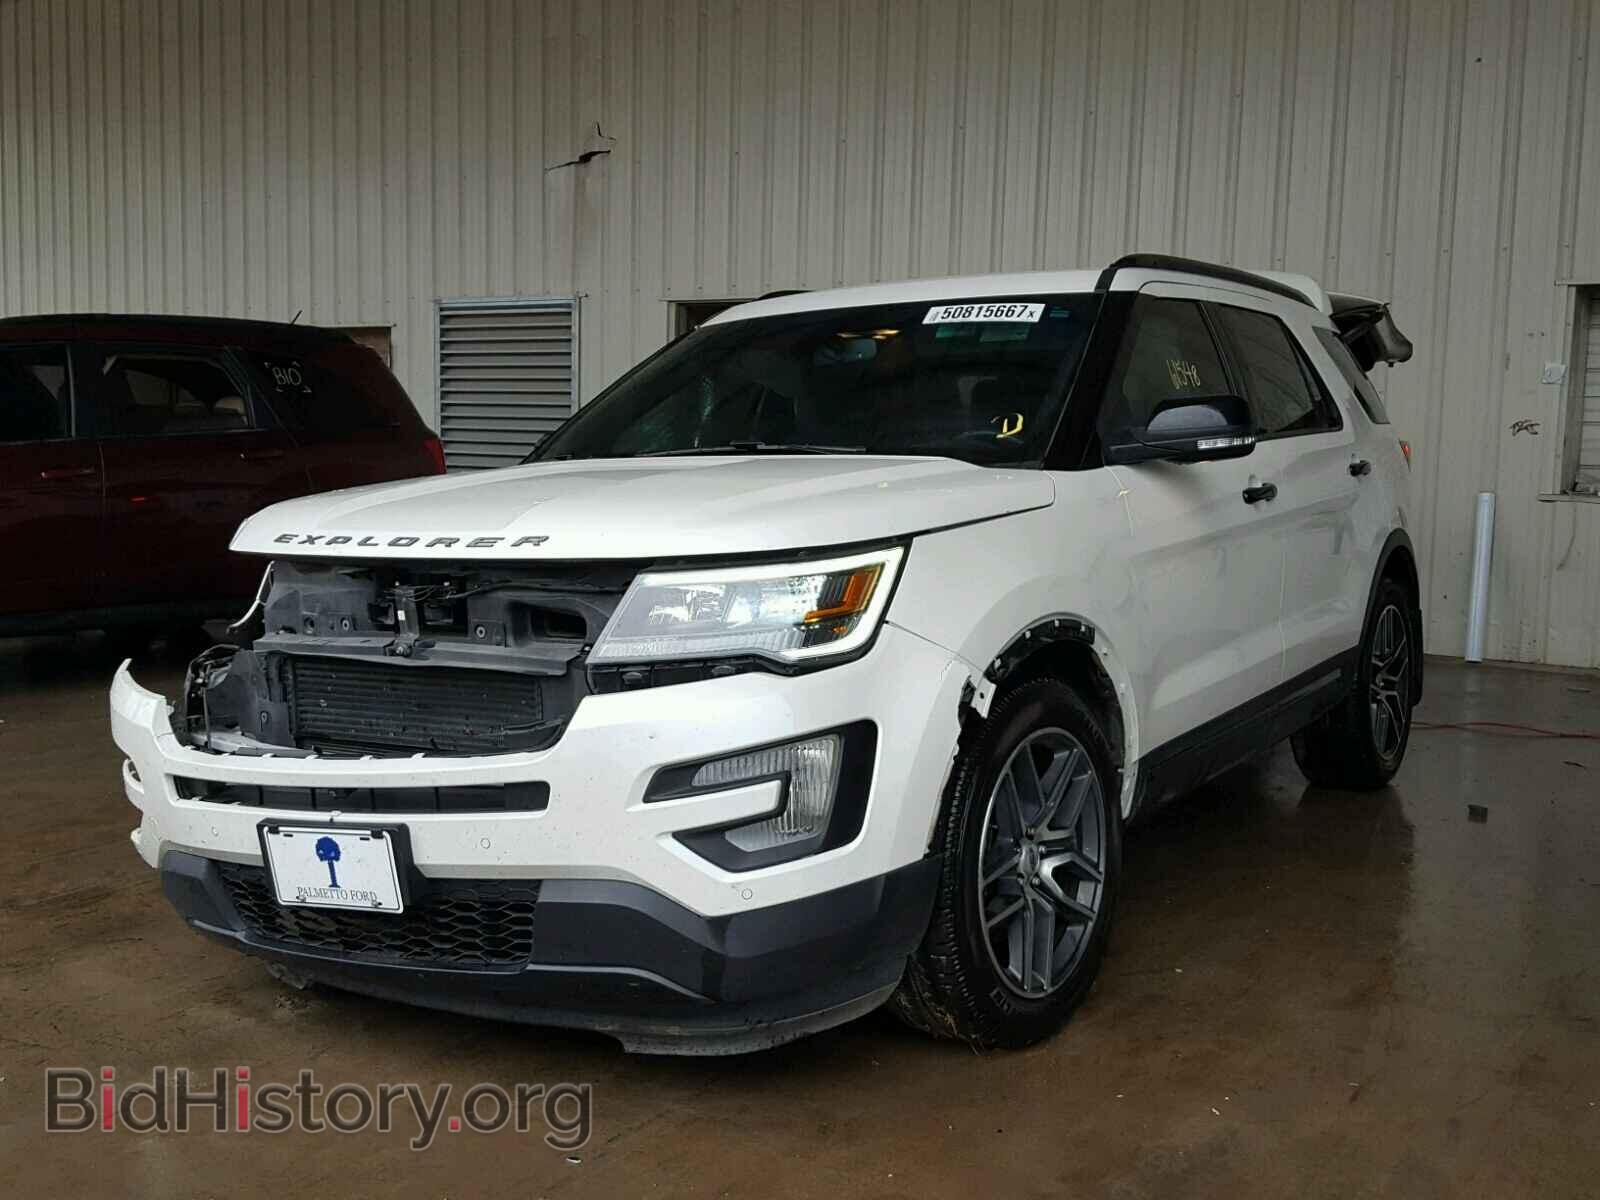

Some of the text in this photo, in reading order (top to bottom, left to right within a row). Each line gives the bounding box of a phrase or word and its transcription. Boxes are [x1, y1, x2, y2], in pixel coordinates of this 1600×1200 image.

[941, 305, 1028, 320] 50815667
[273, 532, 550, 549] EXPLORER
[296, 886, 348, 900] PALMETTO
[350, 889, 378, 902] FORD
